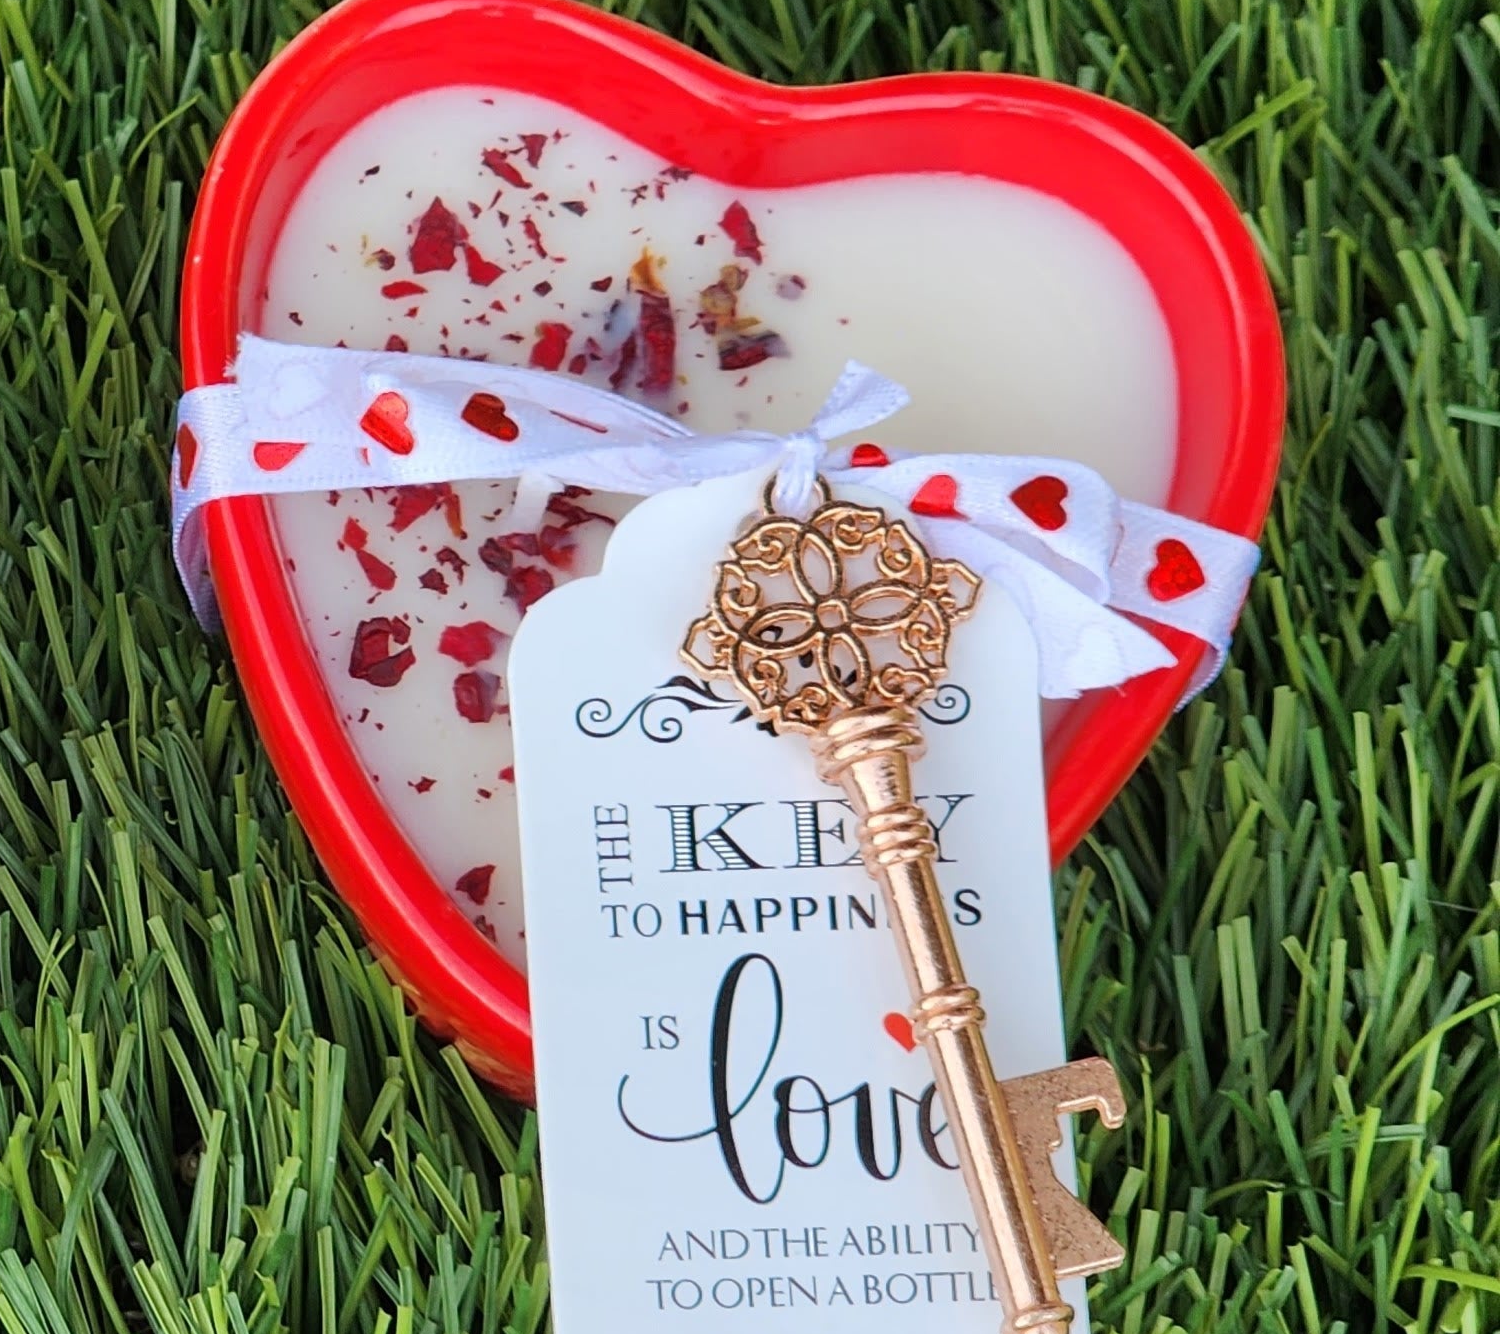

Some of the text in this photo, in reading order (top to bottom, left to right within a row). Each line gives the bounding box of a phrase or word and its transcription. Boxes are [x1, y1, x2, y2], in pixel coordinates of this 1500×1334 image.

[594, 803, 634, 894] THE
[601, 889, 982, 938] TO HAPPINS
[618, 953, 960, 1204] IS love
[658, 1223, 977, 1261] AND THE ABILITY
[645, 1278, 703, 1310] TO
[710, 1276, 818, 1309] OPEN
[827, 1276, 854, 1305] A
